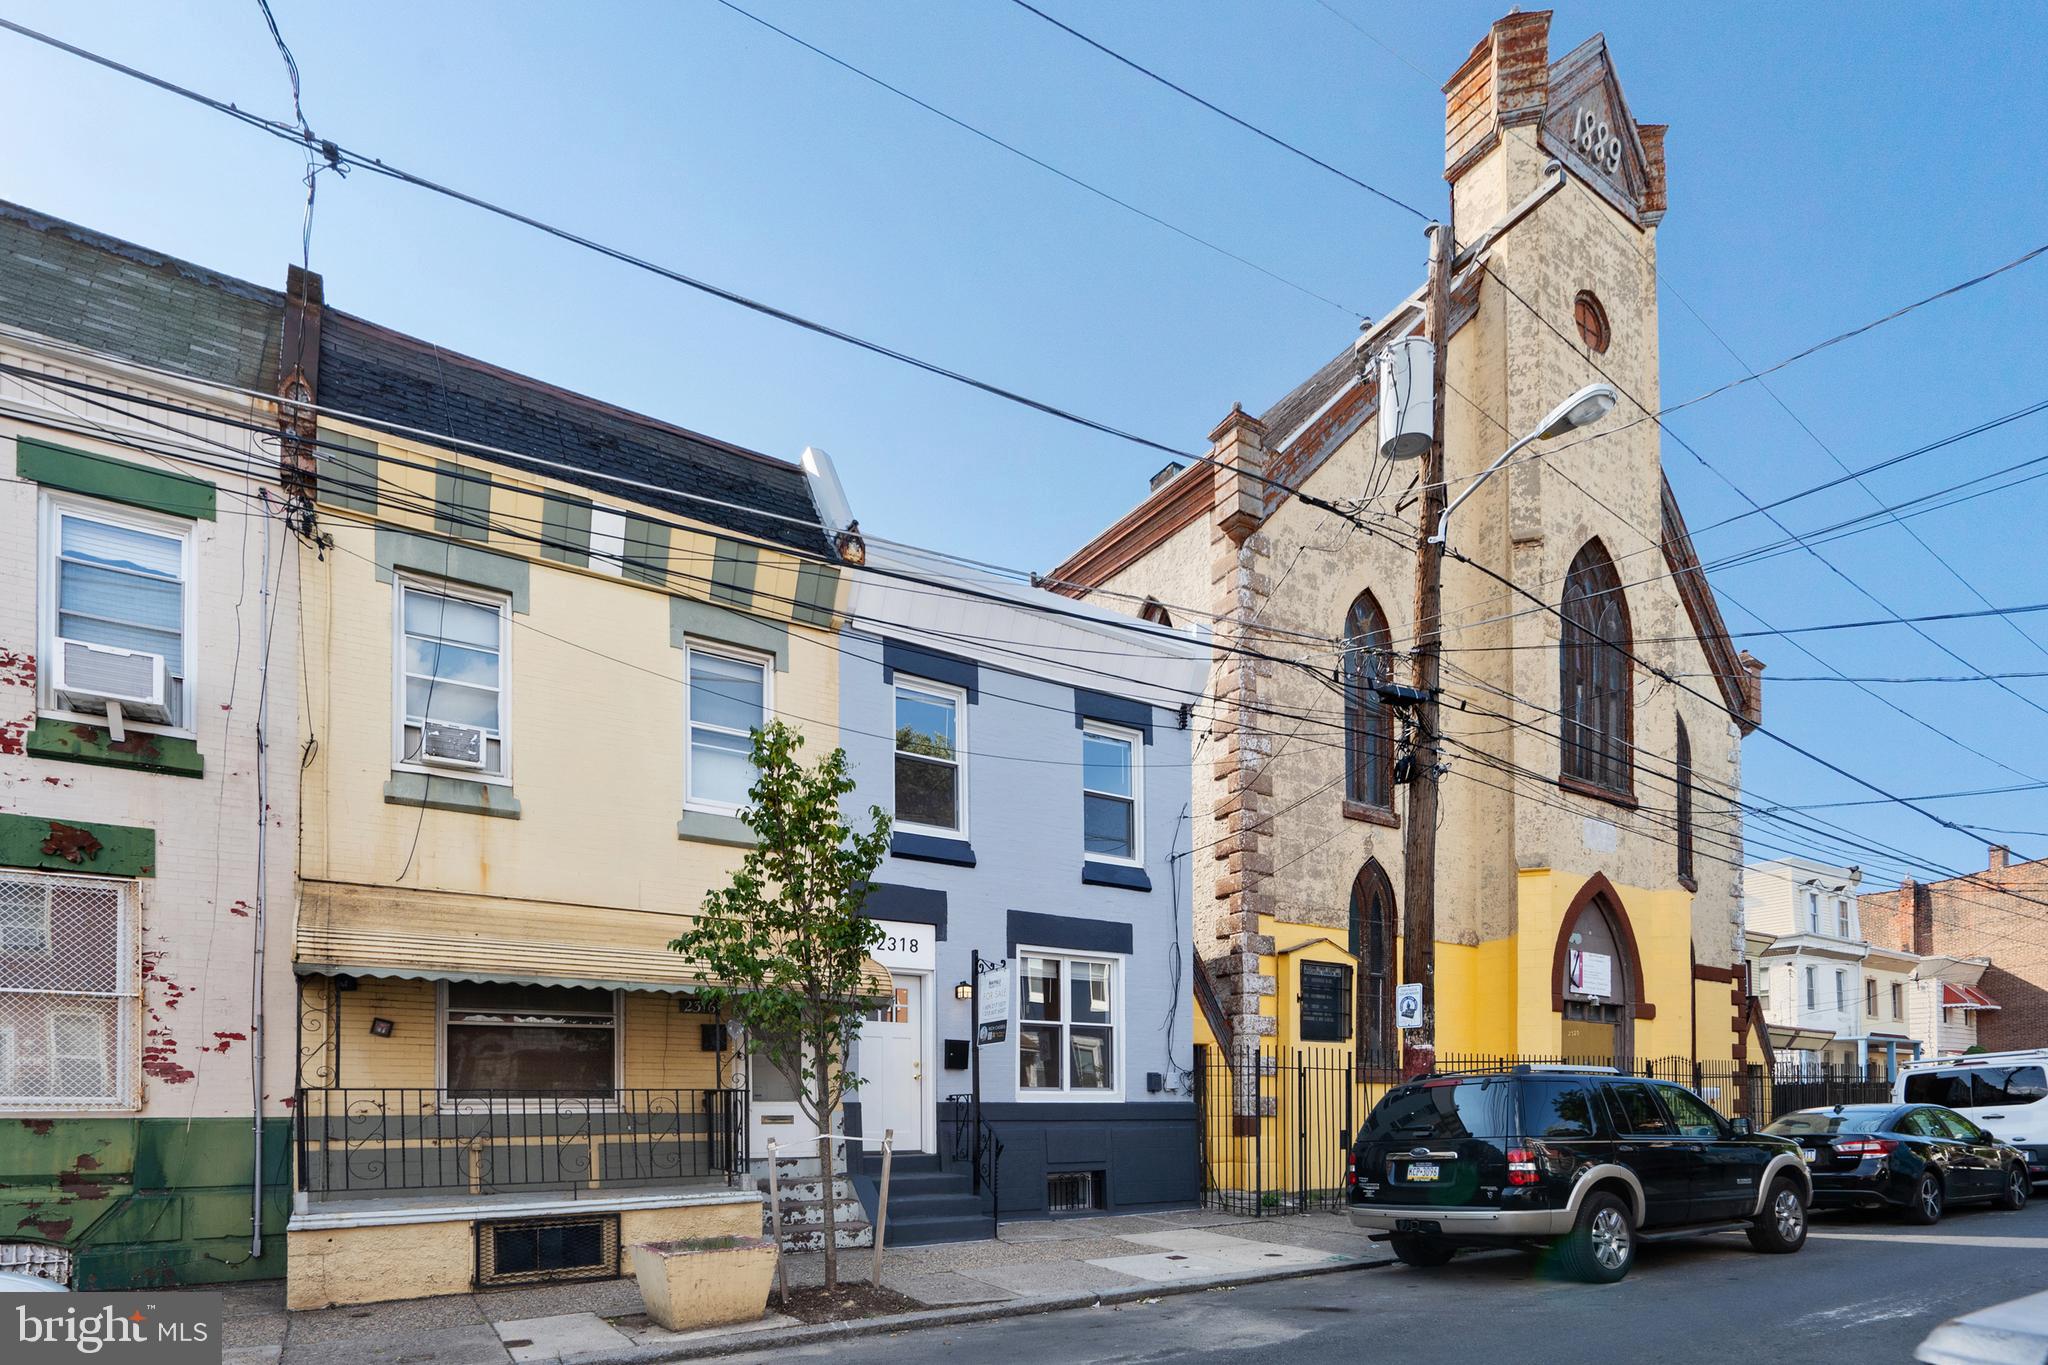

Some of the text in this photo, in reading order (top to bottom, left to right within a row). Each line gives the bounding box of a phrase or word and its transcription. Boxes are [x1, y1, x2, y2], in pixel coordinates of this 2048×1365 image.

[1573, 106, 1622, 174] 1889
[877, 936, 919, 953] 2318
[983, 988, 1008, 1001] FOR SALE
